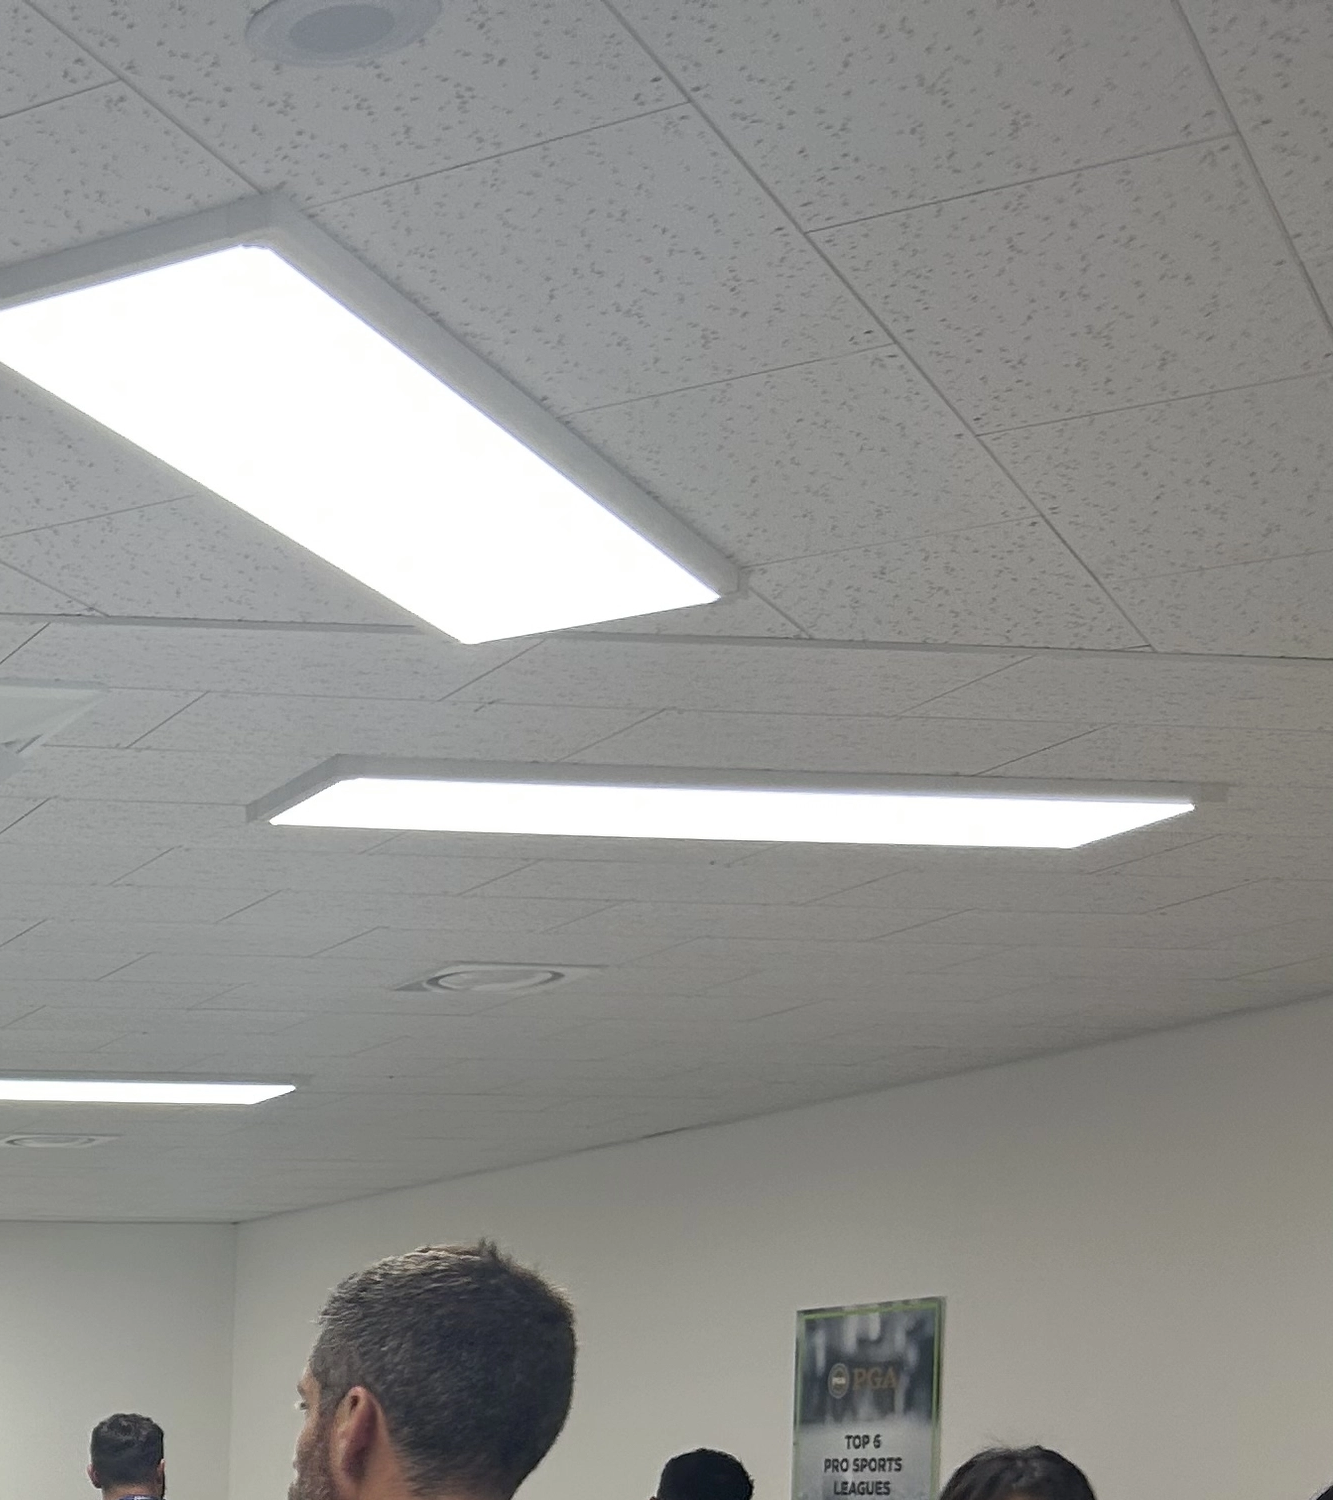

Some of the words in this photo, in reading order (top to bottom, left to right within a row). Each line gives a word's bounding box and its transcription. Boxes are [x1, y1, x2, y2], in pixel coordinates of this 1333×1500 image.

[844, 1434, 870, 1450] TOP
[873, 1434, 882, 1450] 6
[824, 1457, 850, 1473] PRO
[852, 1456, 903, 1473] SPORTS
[833, 1480, 891, 1496] LEAGUES
